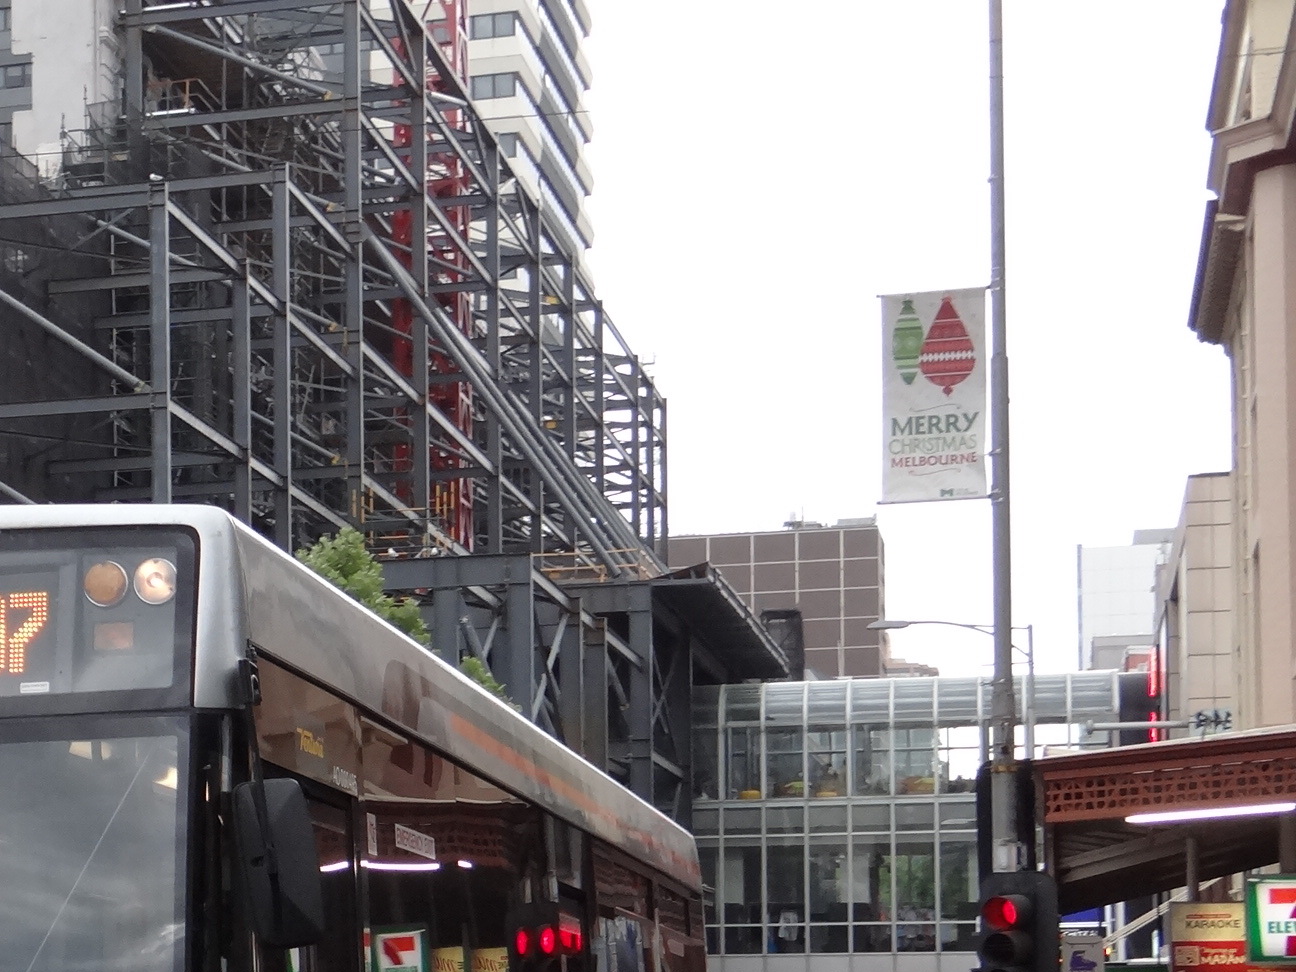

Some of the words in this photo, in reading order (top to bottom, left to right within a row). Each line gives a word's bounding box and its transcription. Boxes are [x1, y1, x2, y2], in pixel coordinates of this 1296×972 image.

[891, 411, 980, 436] MERRY
[889, 434, 977, 455] CHRISTMAS
[891, 452, 978, 468] MELBOURNE
[1185, 919, 1242, 929] KARAOKE
[1267, 920, 1296, 934] ELE
